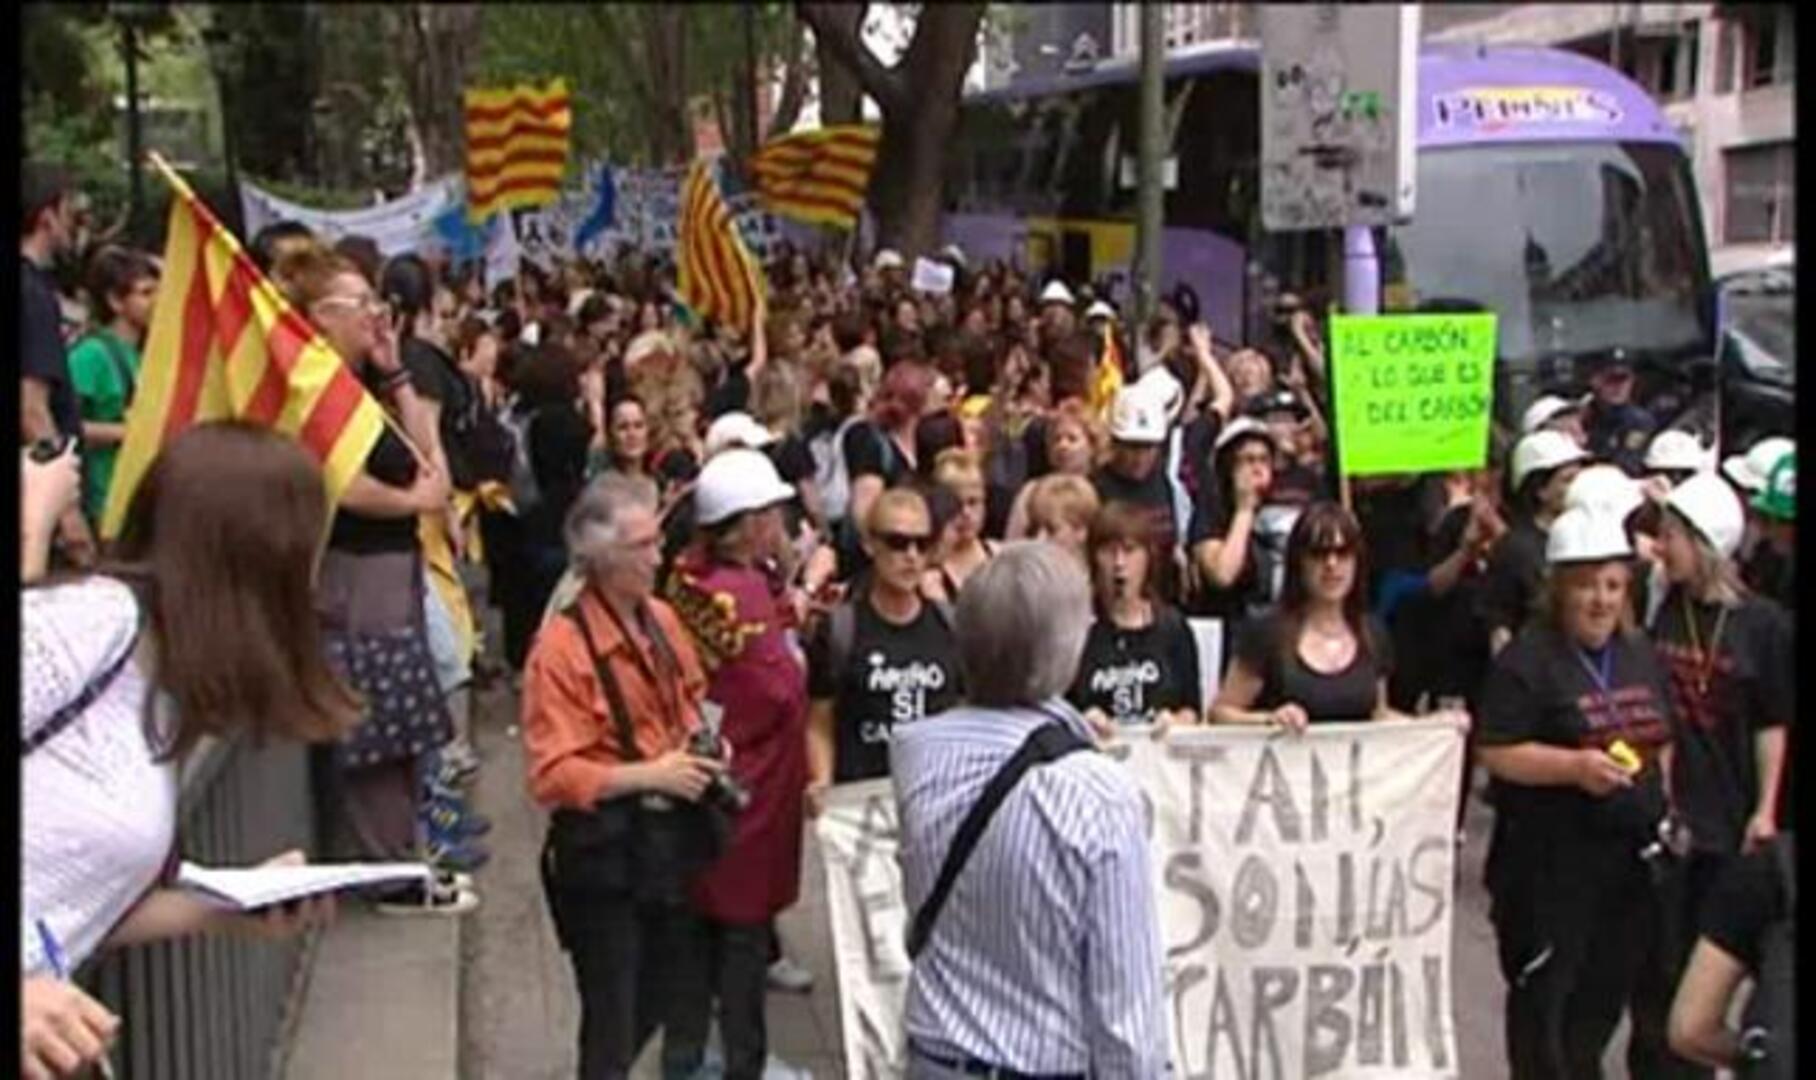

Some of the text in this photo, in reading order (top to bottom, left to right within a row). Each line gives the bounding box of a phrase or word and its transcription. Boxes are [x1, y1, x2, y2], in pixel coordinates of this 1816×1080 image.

[1371, 364, 1398, 389] LO
[1407, 362, 1446, 388] QUE
[1366, 401, 1407, 425] DEL
[1106, 739, 1385, 848] TAN,
[1363, 837, 1450, 941] LAS
